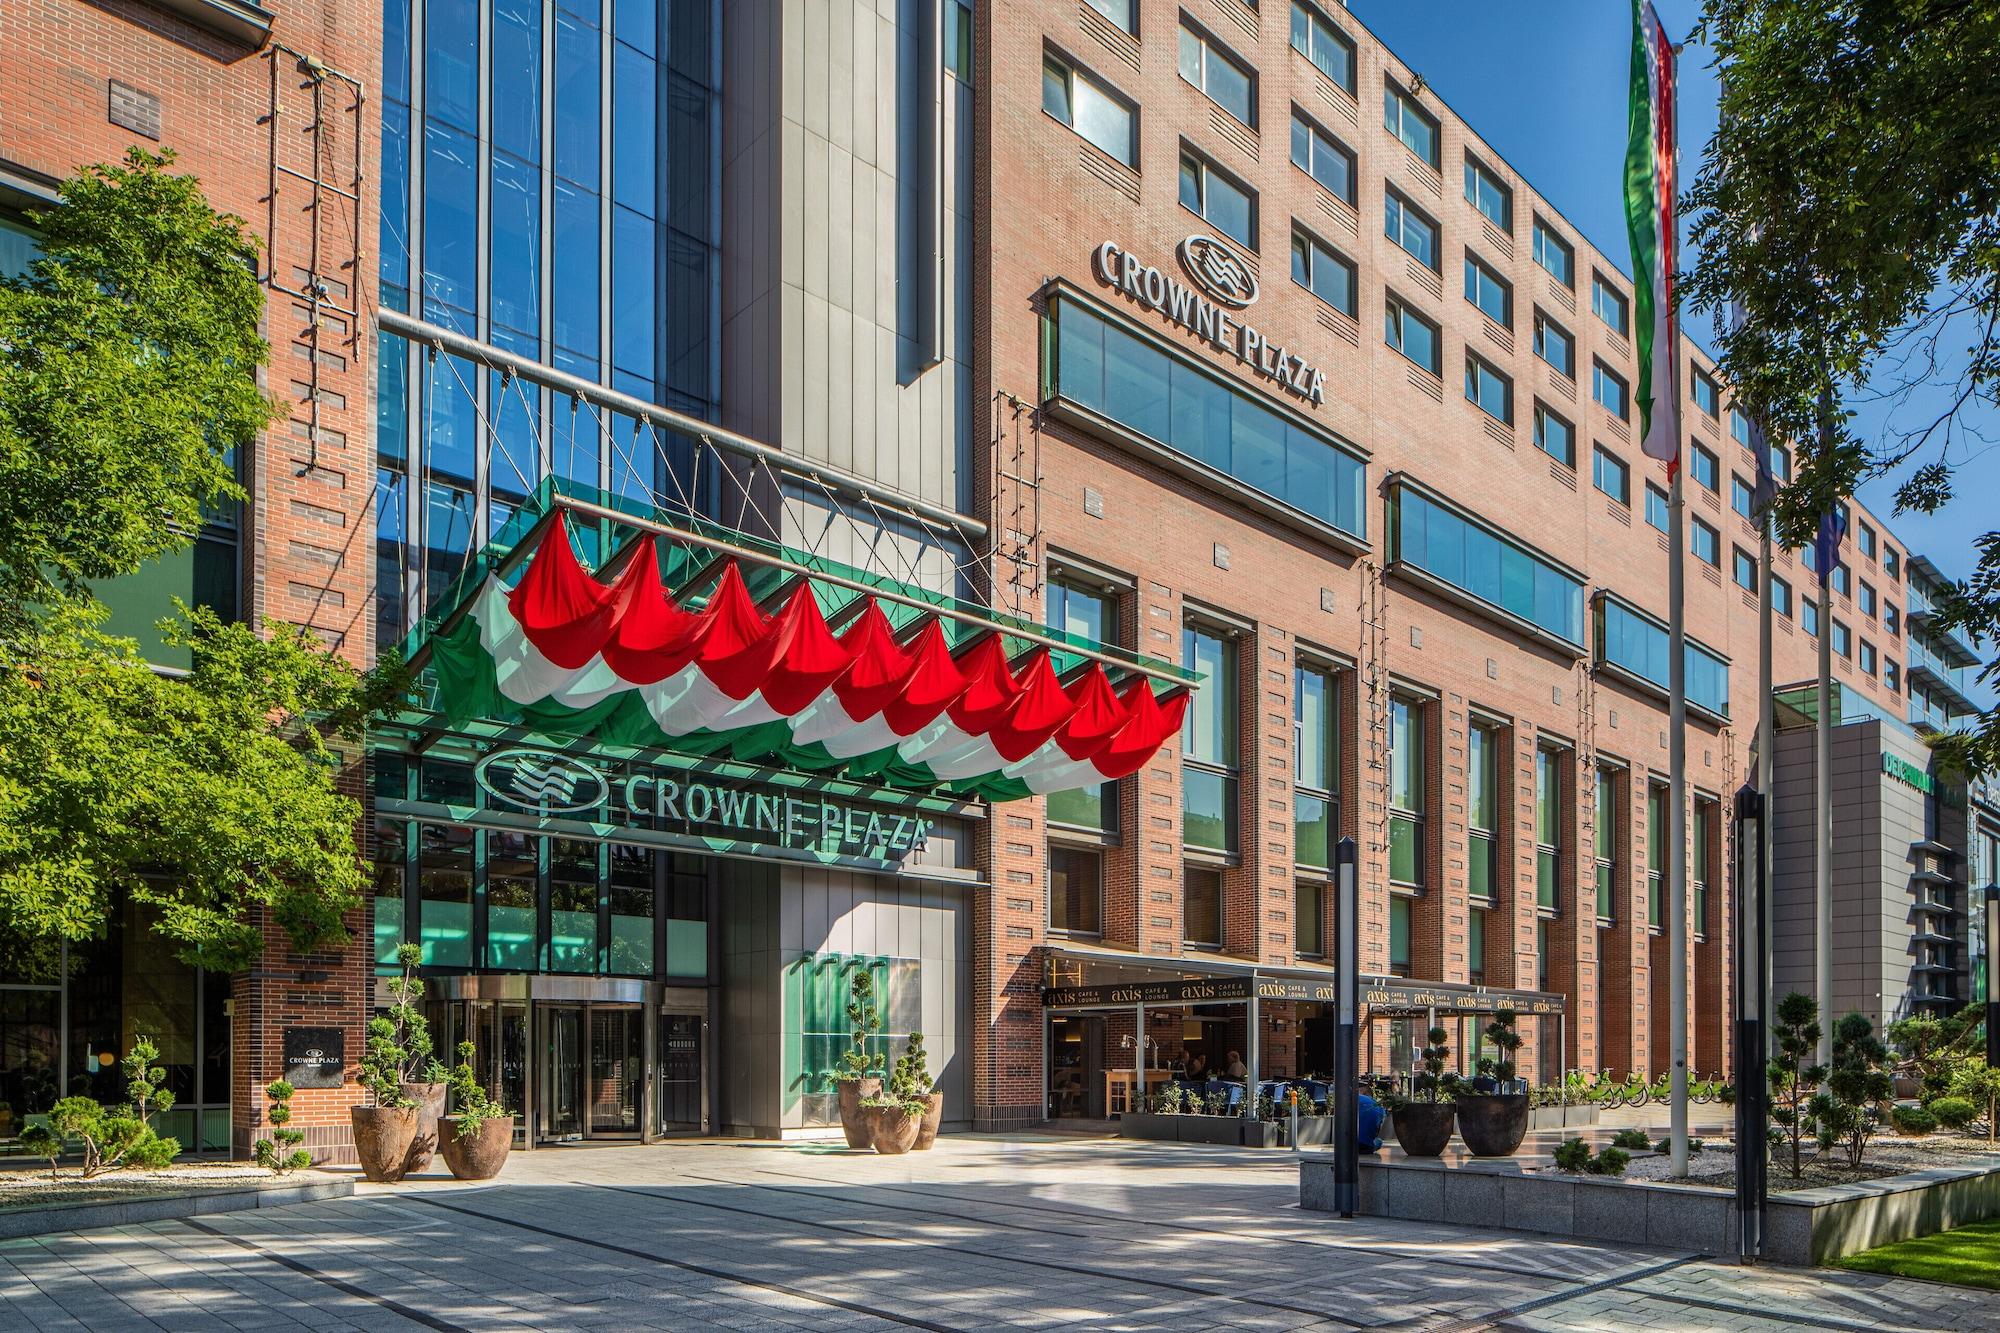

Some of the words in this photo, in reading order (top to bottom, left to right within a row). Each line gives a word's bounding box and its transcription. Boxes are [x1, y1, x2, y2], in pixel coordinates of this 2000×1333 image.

[1100, 240, 1234, 350] CROWNE
[1242, 324, 1326, 405] PLAZA
[626, 774, 808, 837] CROWNE
[822, 803, 934, 852] PLAZA
[1048, 989, 1076, 1004] axis
[1111, 985, 1142, 1001] axis
[1181, 981, 1214, 998] axis
[1258, 980, 1286, 997] axis
[1316, 983, 1334, 1000] axi
[1367, 987, 1389, 1003] axis
[1414, 990, 1435, 1005] axis
[1456, 993, 1476, 1008] axis
[1497, 996, 1515, 1010] axis
[1533, 1000, 1550, 1013] axis
